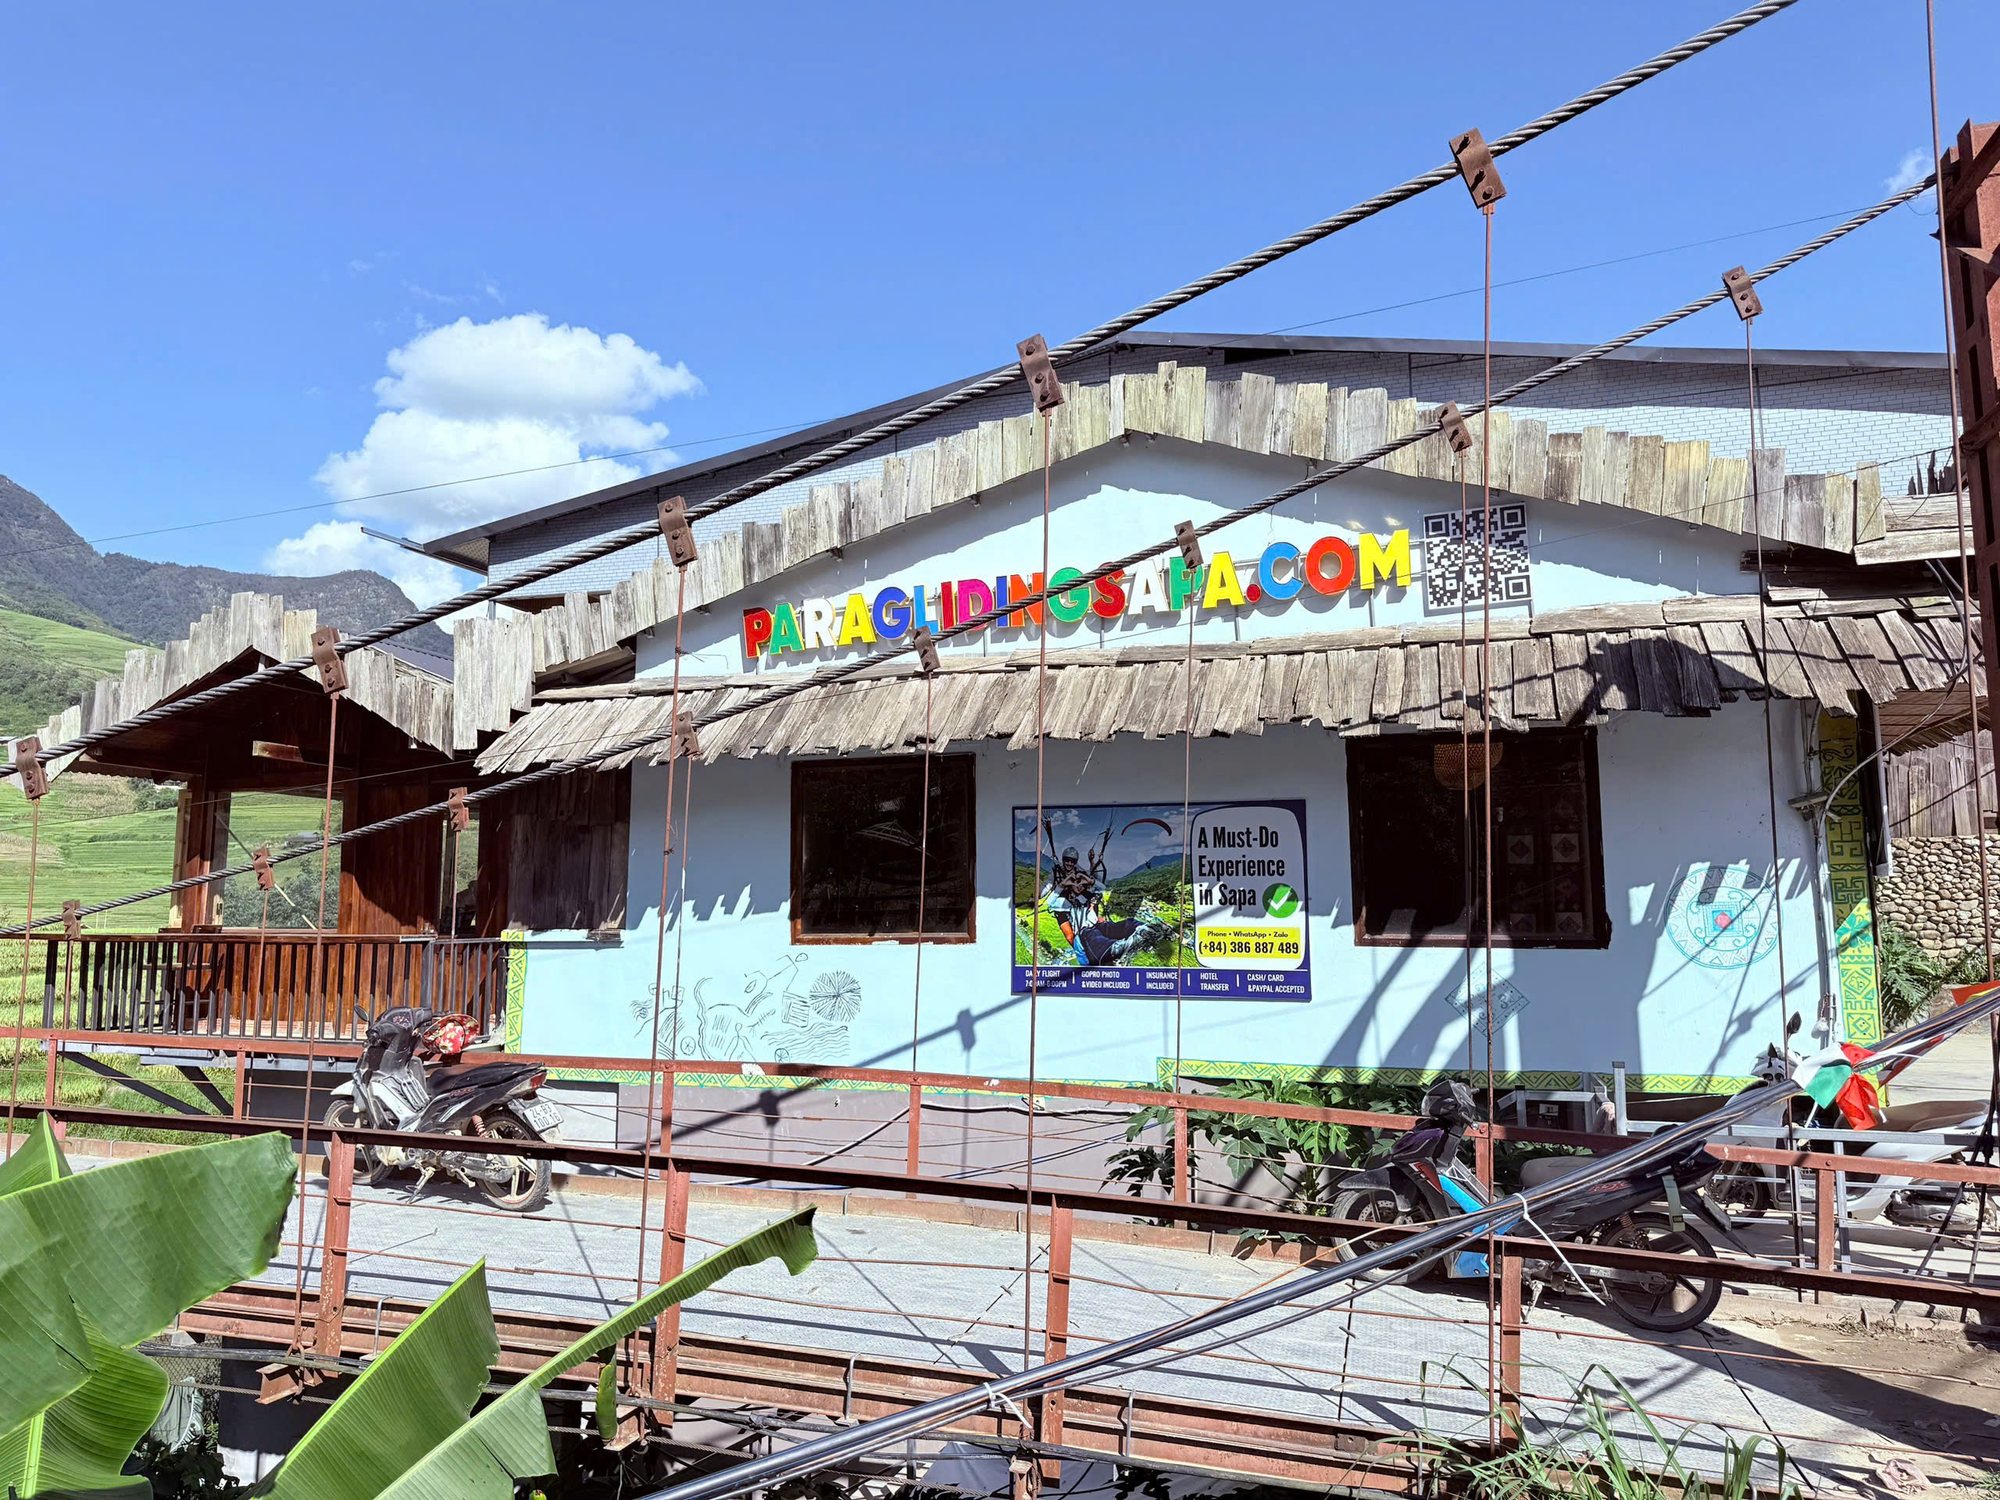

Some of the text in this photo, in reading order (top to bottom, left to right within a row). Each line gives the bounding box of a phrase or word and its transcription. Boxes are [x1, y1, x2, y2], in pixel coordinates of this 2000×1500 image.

[743, 528, 1411, 658] PARAGLIDINGSAPA.COM
[1198, 826, 1279, 848] A Must-Do
[1198, 854, 1285, 882] Experience
[1199, 884, 1256, 911] in Sapa
[1233, 931, 1267, 939] WhatsApp
[1198, 941, 1299, 955] (+84) 386 887 489
[1042, 970, 1060, 978] FLIGHT
[1081, 970, 1101, 978] GOPRO
[1146, 971, 1178, 980] INSURANCE
[1200, 972, 1218, 980] HOTEL
[1267, 974, 1285, 982] CARD
[1103, 981, 1130, 989] INCLUDED
[1146, 982, 1174, 990] INCLUDED
[1200, 983, 1229, 991] TRANSFER
[1275, 985, 1305, 994] ACCEPTED
